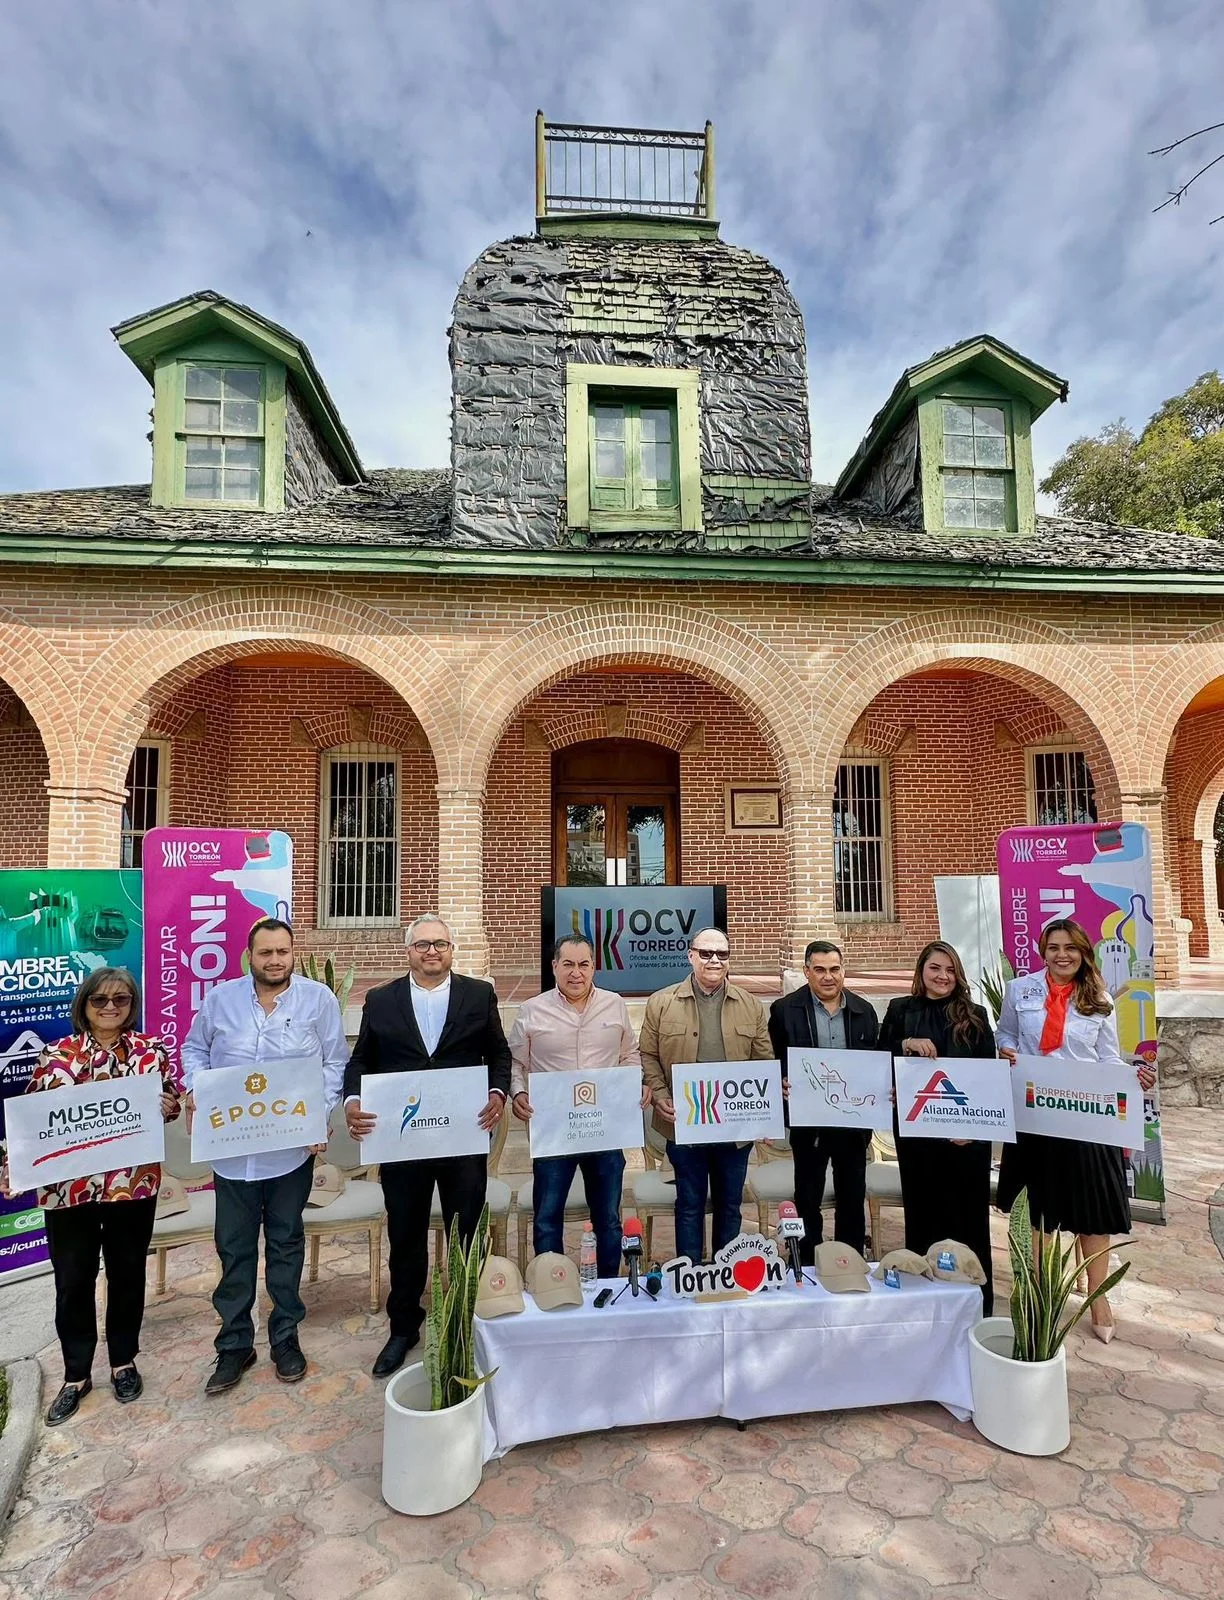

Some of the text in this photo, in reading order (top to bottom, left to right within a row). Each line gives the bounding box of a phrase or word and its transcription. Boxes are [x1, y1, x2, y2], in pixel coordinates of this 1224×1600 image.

[188, 841, 221, 853] OCV
[1035, 837, 1067, 849] OCV
[629, 908, 697, 935] OCV
[161, 925, 177, 1001] VISITAR
[181, 895, 227, 1032] EÓN!
[0, 989, 70, 1002] ransportadoras
[39, 1005, 53, 1013] DE
[161, 1003, 177, 1018] A
[722, 1078, 769, 1098] OCV
[723, 1098, 770, 1111] TORREÓN
[922, 1105, 1006, 1118] Alianza Nacional
[1035, 1095, 1116, 1117] COAHUILA
[49, 1097, 130, 1128] MUSEO
[208, 1099, 306, 1130] ÉPOCA
[568, 1109, 603, 1120] Dirección
[39, 1112, 142, 1140] DE LA REVOLUCIÓN
[410, 1116, 450, 1128] ammca
[567, 1129, 605, 1140] de Turismo
[720, 1238, 774, 1264] Enamórate de
